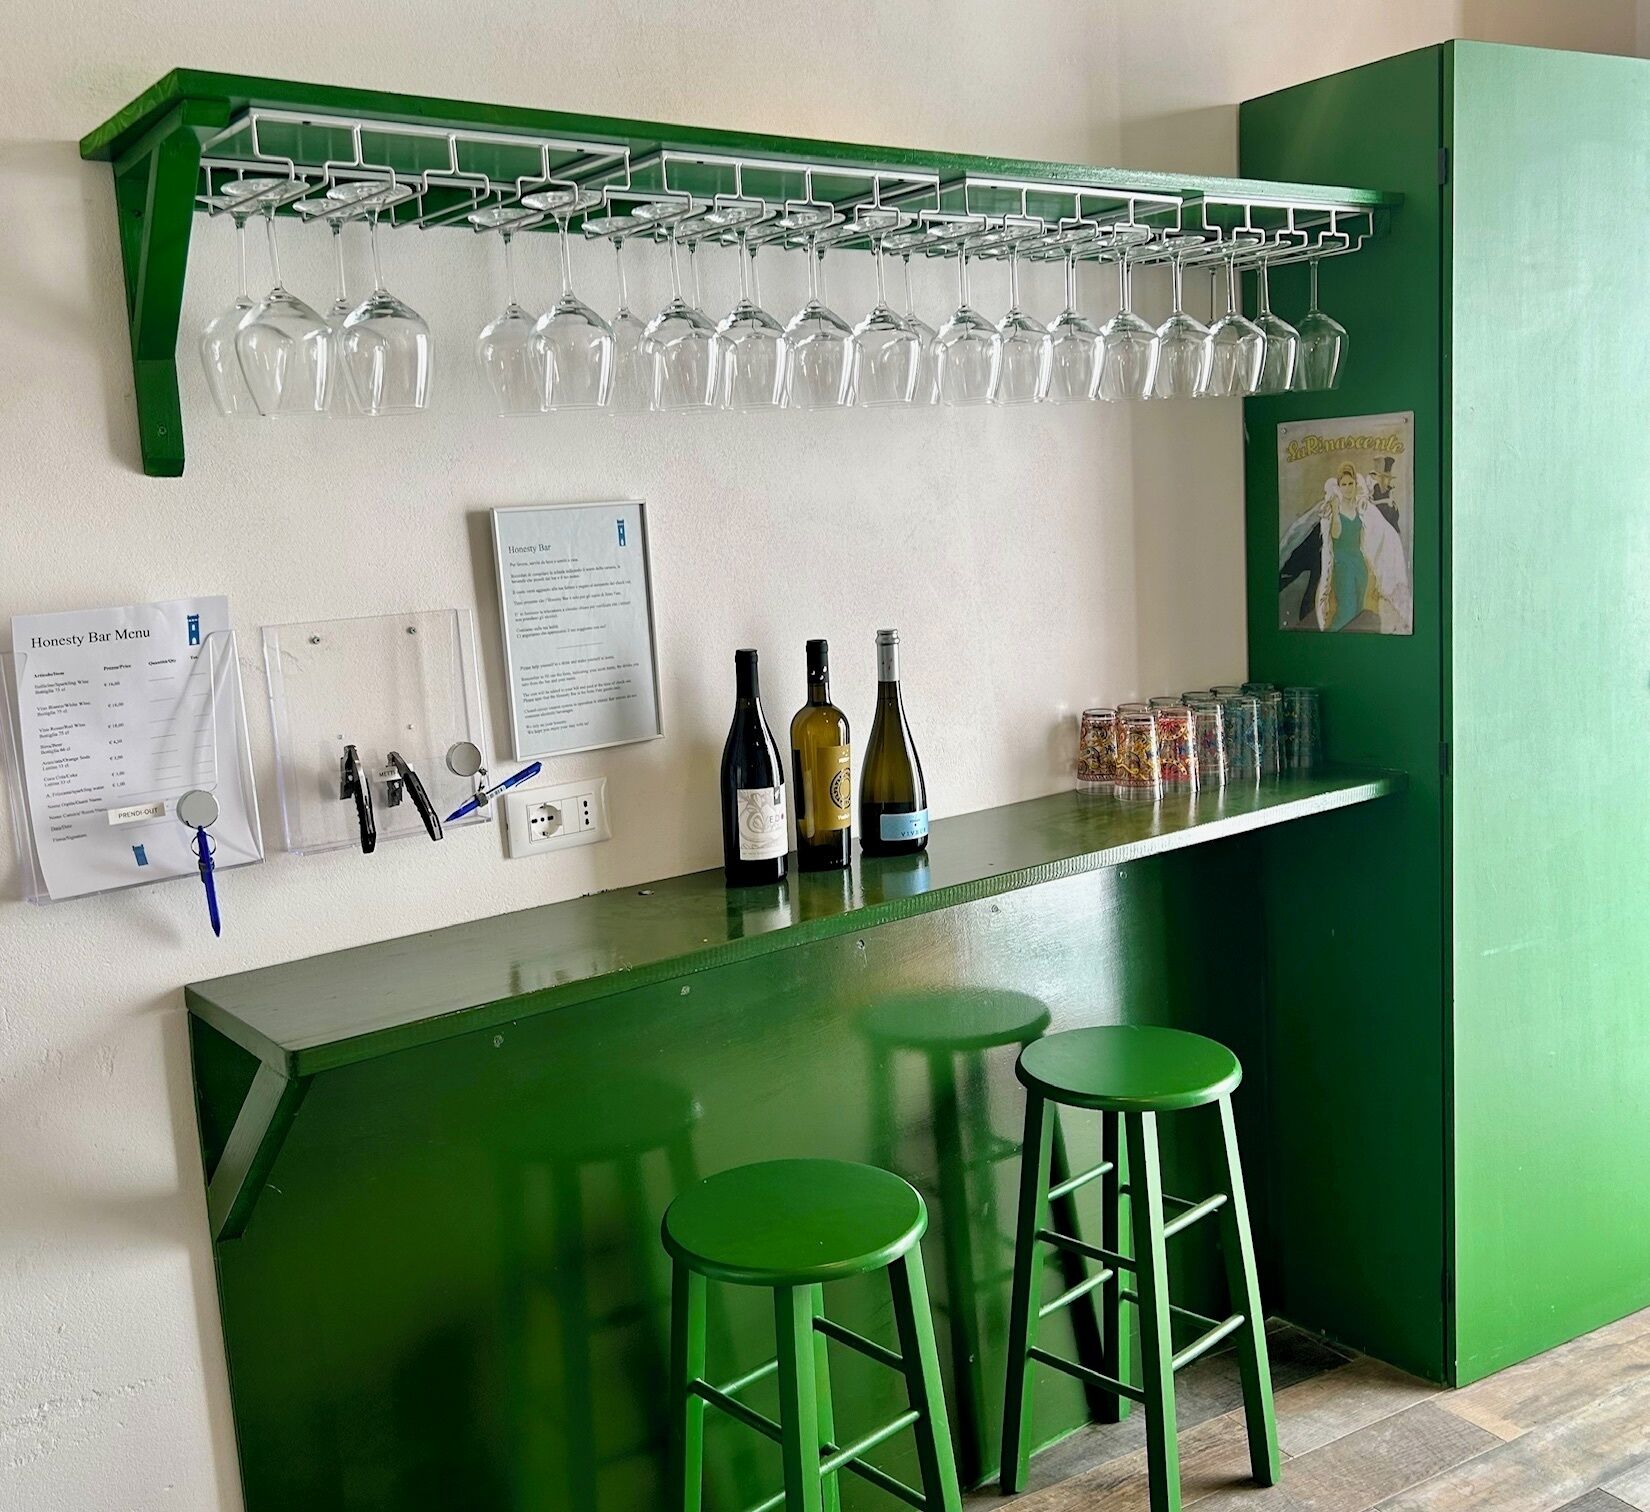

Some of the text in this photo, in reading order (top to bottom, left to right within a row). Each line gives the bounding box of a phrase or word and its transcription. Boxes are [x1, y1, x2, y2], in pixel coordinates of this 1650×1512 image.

[508, 543, 552, 554] Honesty Bar
[31, 629, 151, 649] Honesty Bar Menu
[118, 807, 158, 819] PRENDI-OUT
